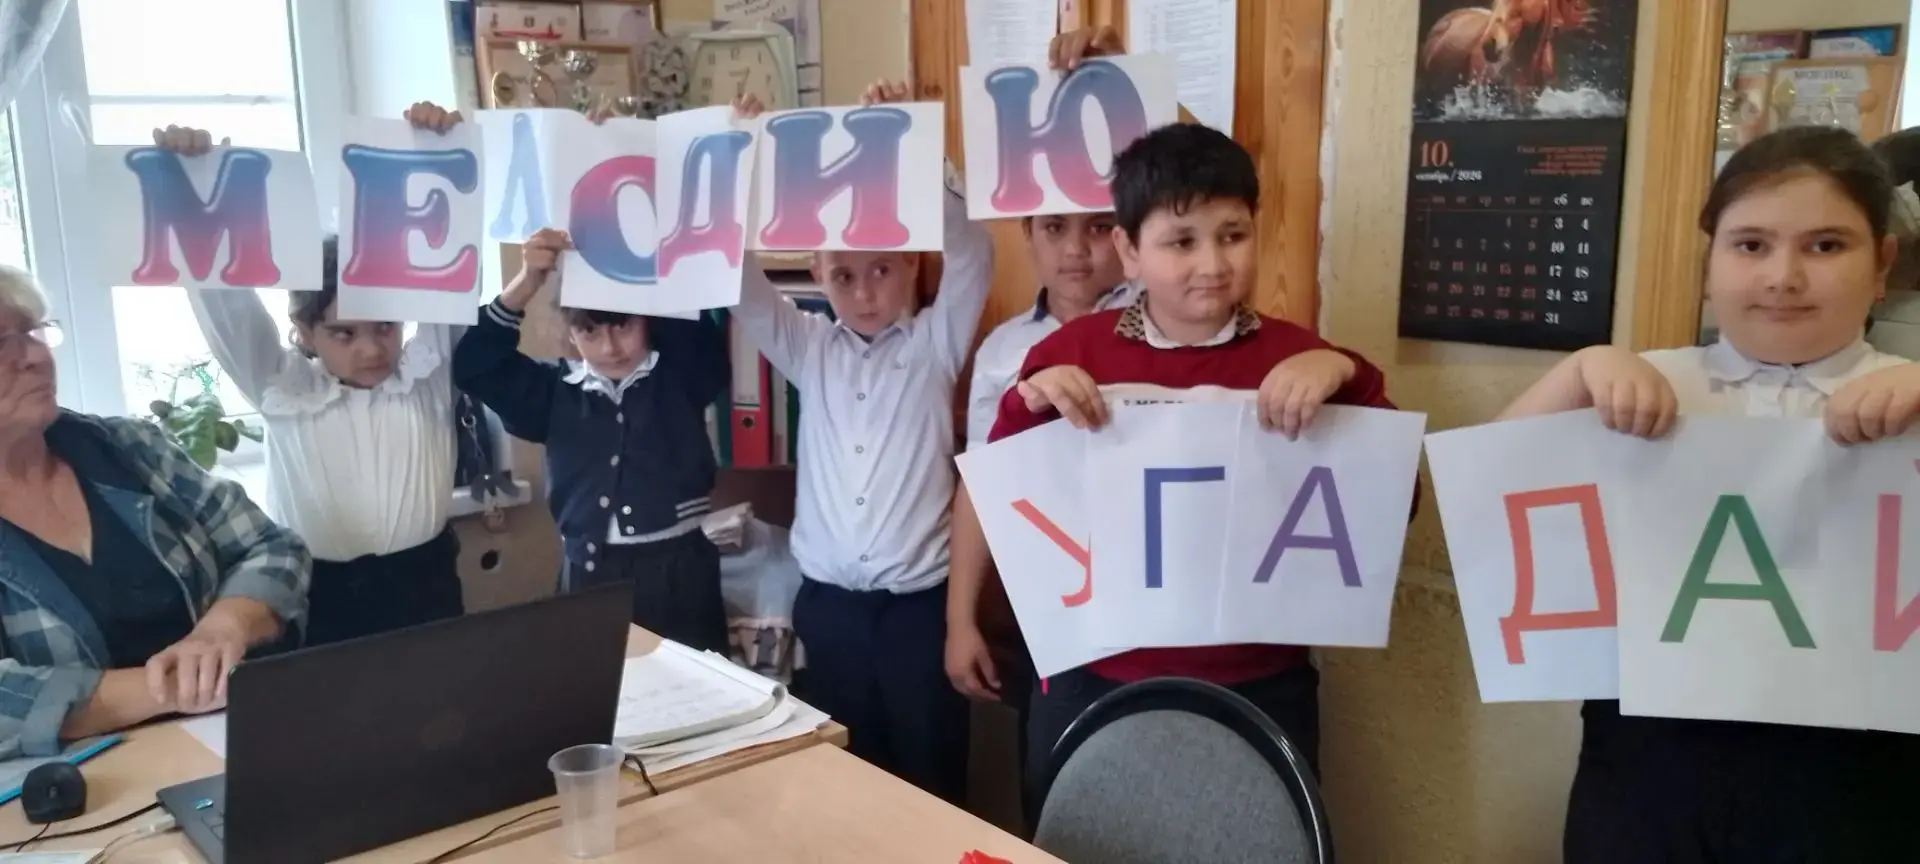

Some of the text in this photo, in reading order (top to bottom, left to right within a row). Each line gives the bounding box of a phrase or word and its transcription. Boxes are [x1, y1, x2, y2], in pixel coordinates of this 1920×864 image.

[1554, 216, 1563, 230] 3
[1551, 242, 1565, 254] 10
[1578, 242, 1590, 254] 11
[1549, 265, 1562, 278] 17
[1575, 267, 1590, 279] 18
[1546, 289, 1561, 302] 24
[1572, 290, 1588, 303] 25
[1545, 312, 1559, 325] 31
